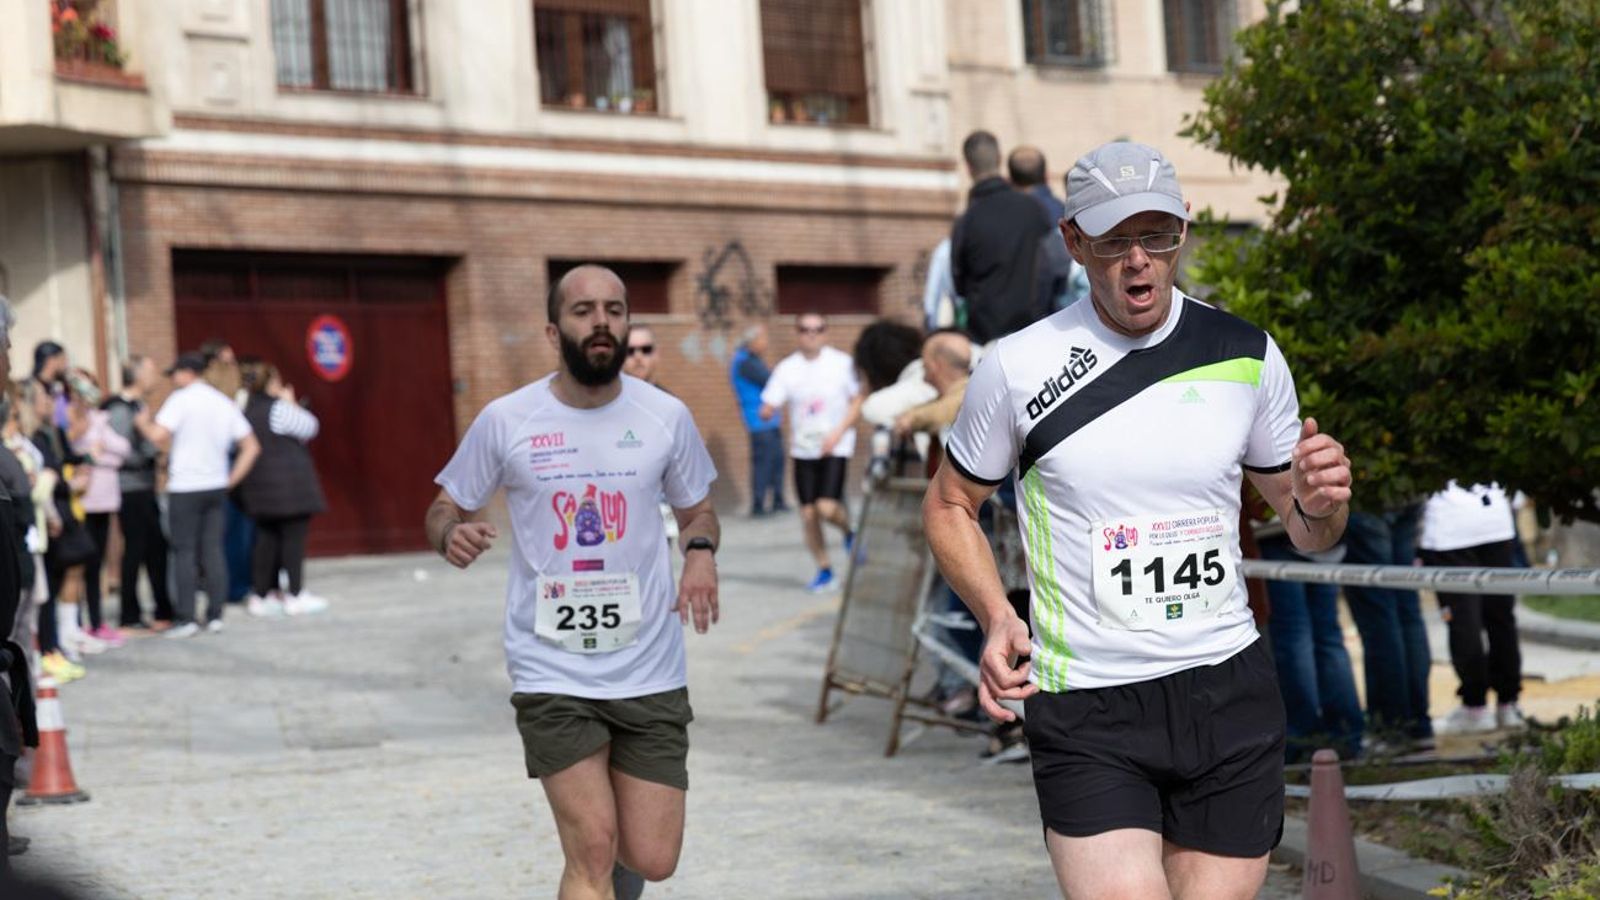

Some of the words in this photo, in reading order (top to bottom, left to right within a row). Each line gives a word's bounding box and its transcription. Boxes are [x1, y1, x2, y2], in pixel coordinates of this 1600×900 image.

[1025, 347, 1098, 420] adidas
[530, 432, 565, 448] XXVII
[1110, 548, 1226, 595] 1145
[1155, 594, 1182, 604] QUIERO
[1183, 592, 1200, 601] OLGA
[556, 603, 621, 630] 235
